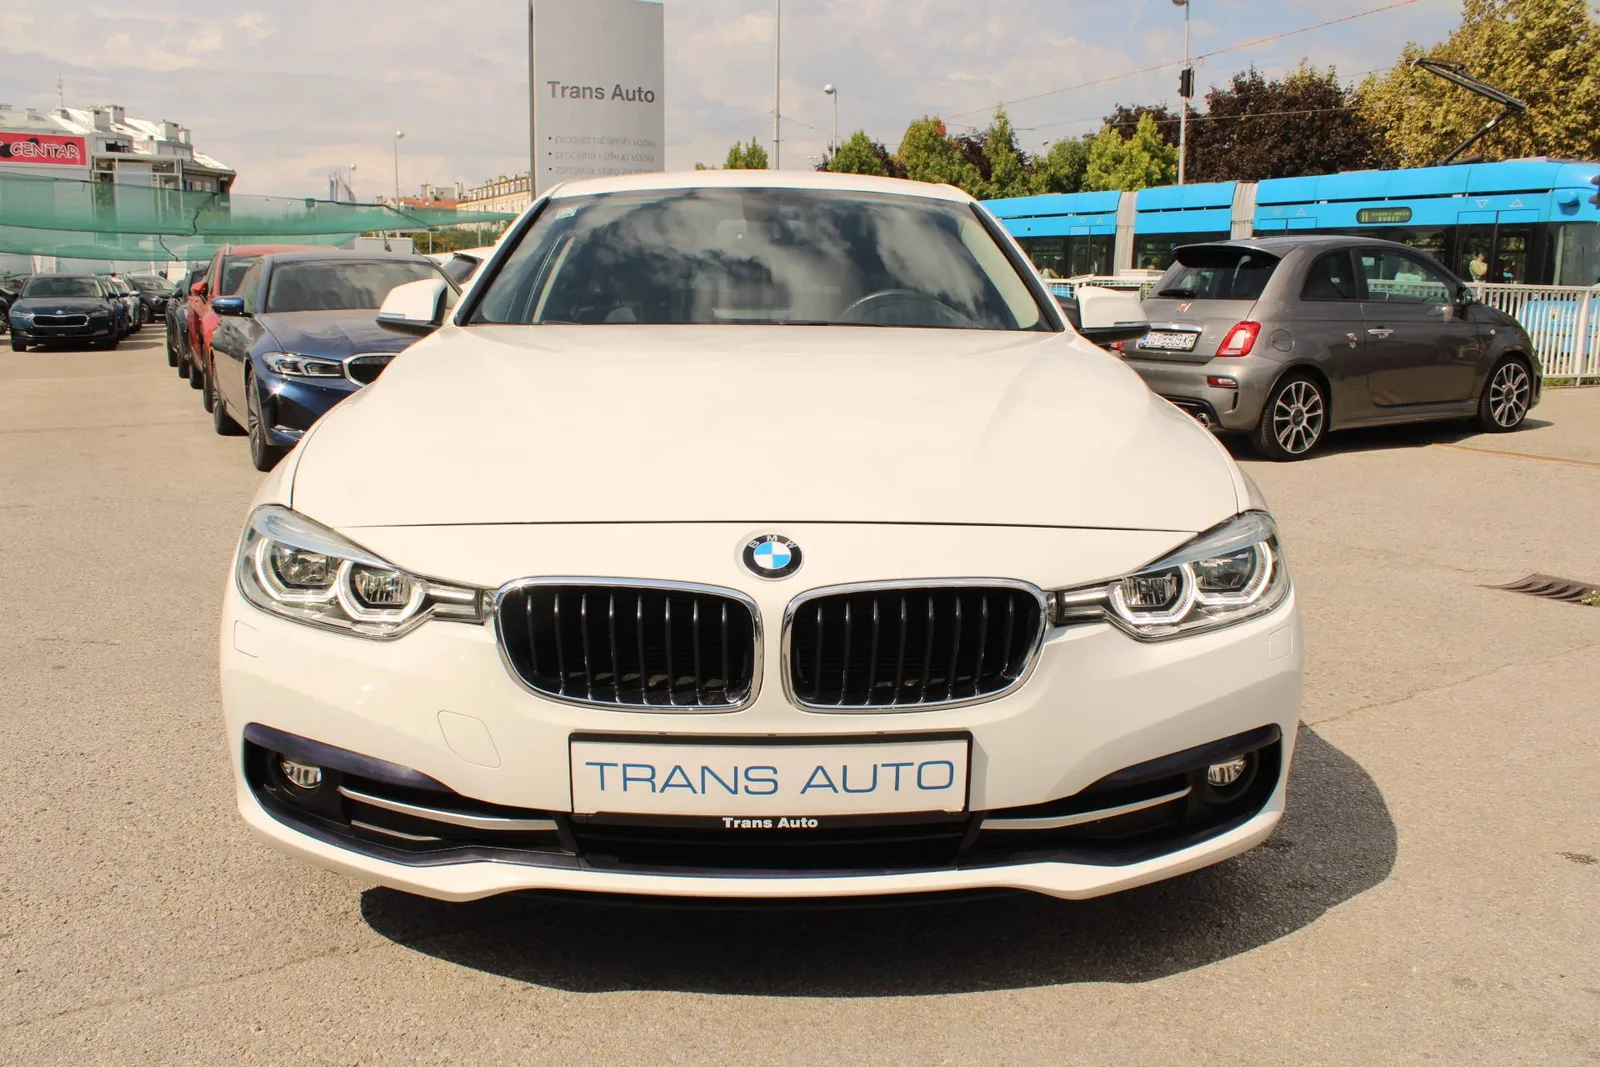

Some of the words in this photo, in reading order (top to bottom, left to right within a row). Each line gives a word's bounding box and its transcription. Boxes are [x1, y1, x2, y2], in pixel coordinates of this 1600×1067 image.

[547, 81, 605, 100] Trans
[611, 84, 655, 103] Auto
[10, 141, 80, 159] CENTAR
[748, 534, 797, 549] BMW
[585, 761, 779, 795] TRANS
[800, 760, 955, 795] AUTO
[722, 817, 773, 828] Trans
[777, 817, 819, 828] Auto
